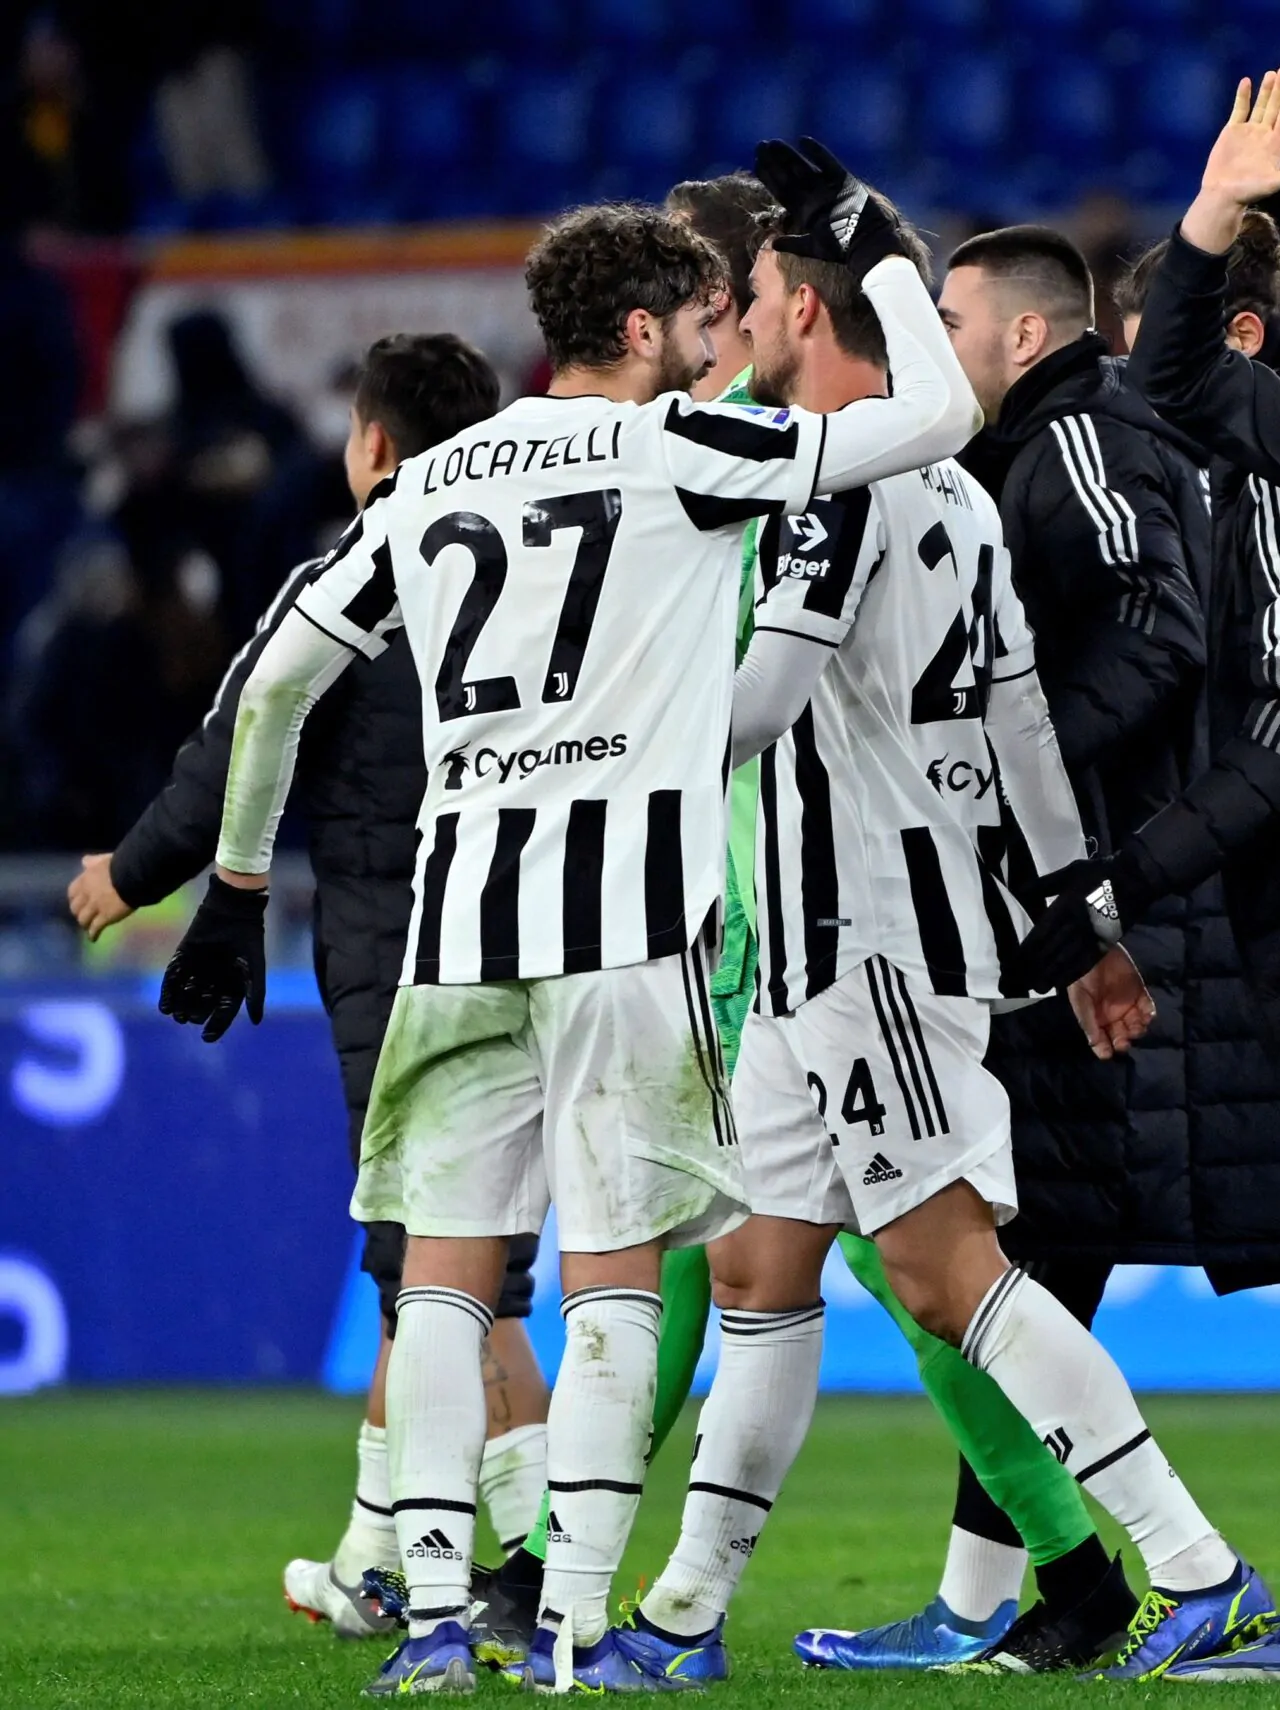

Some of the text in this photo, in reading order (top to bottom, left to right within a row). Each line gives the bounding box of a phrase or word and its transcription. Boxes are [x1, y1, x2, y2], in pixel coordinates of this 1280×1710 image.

[423, 420, 622, 496] LOCATELLI
[418, 487, 623, 723] 27
[862, 1168, 904, 1186] adidas
[406, 1544, 464, 1561] adidas
